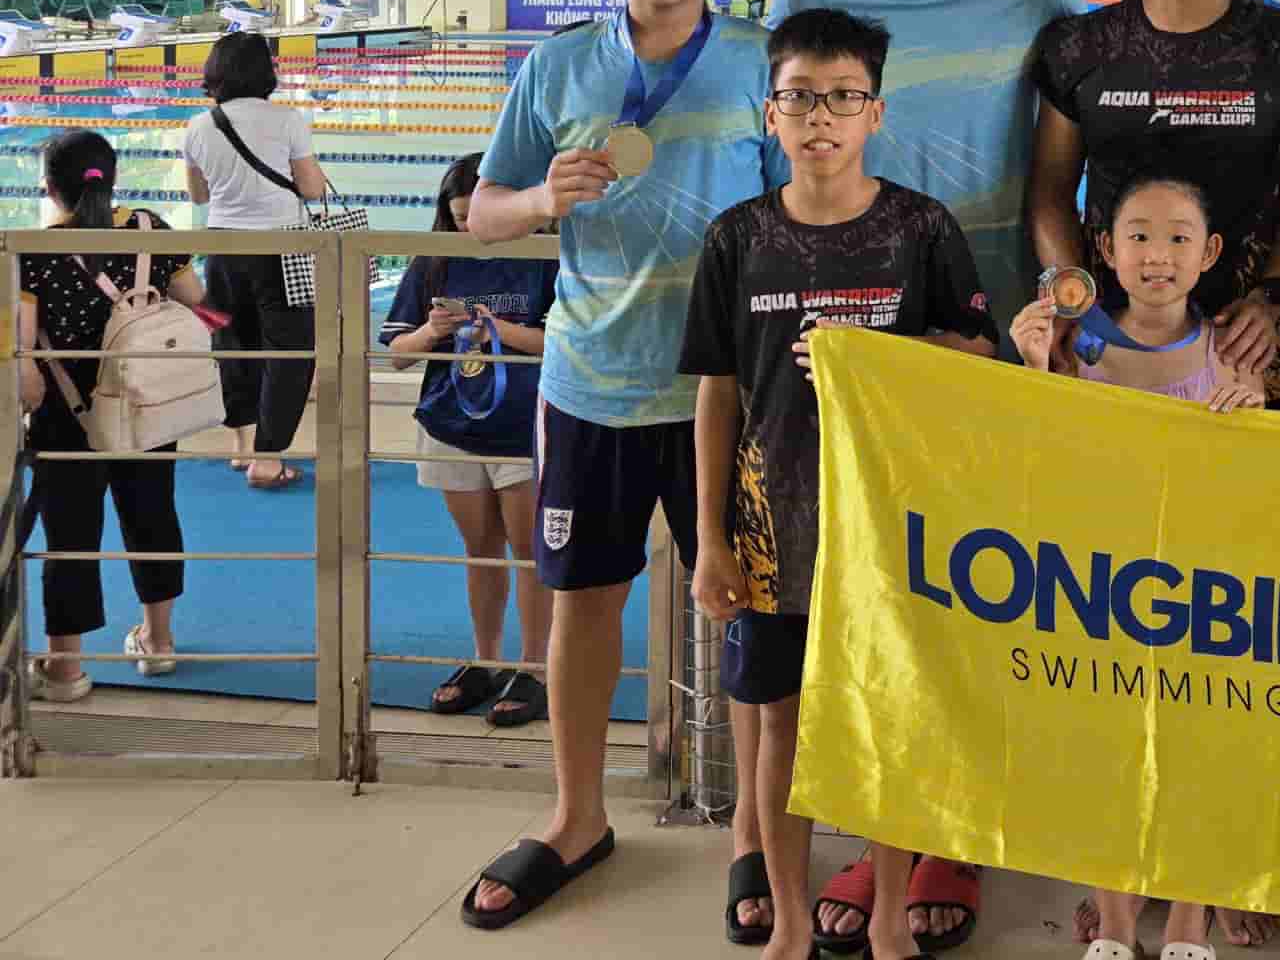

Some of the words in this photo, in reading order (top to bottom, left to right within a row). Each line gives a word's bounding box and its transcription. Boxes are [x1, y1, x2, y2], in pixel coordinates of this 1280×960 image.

[1098, 91, 1150, 107] AQUA
[1152, 90, 1256, 106] WARRIORS
[750, 292, 798, 312] AQUA
[800, 287, 904, 308] WARRIORS
